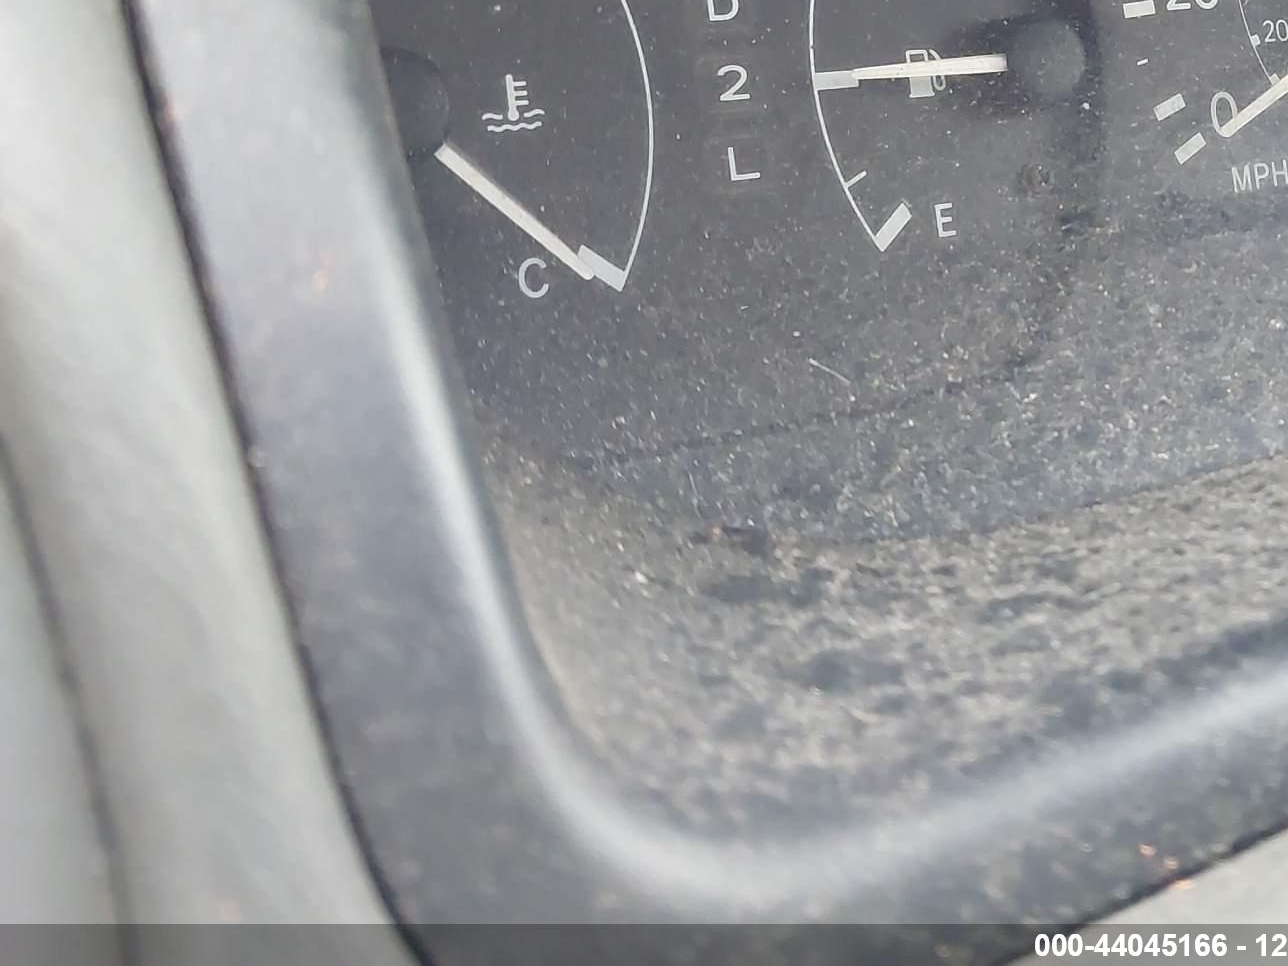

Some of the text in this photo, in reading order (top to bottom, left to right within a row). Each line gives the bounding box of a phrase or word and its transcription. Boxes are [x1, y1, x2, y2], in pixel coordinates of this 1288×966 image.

[716, 64, 750, 101] 2
[1210, 91, 1238, 138] 0
[728, 147, 761, 181] L
[934, 203, 957, 237] E
[518, 257, 549, 298] C
